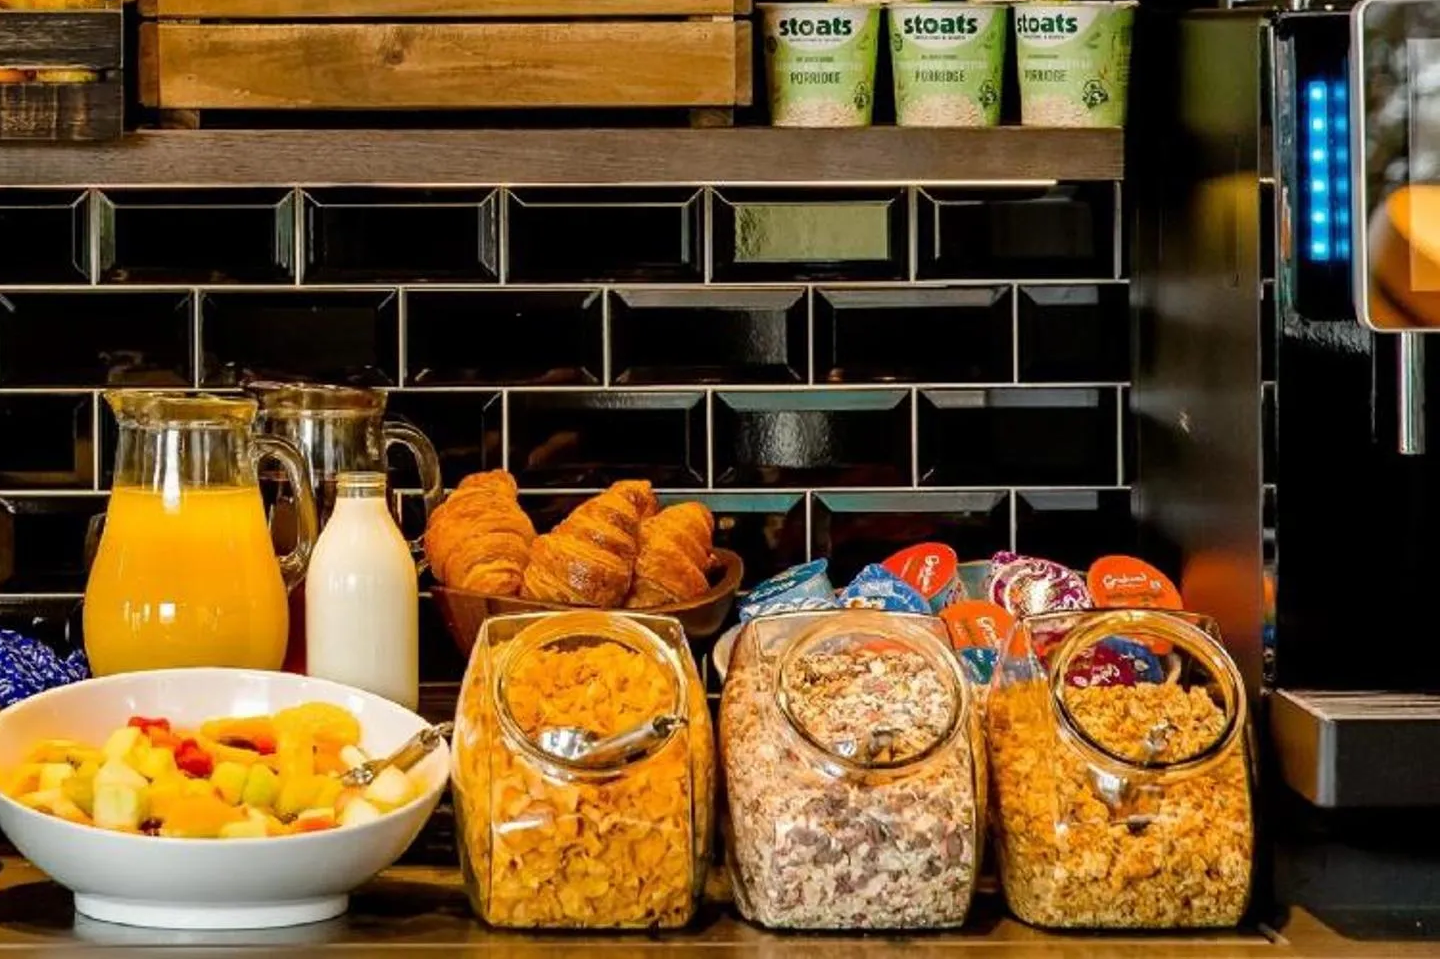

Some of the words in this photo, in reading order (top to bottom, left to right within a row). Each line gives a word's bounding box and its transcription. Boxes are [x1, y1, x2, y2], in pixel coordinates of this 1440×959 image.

[779, 17, 852, 36] stoats
[903, 15, 978, 34] stoats
[1017, 14, 1078, 33] stoats
